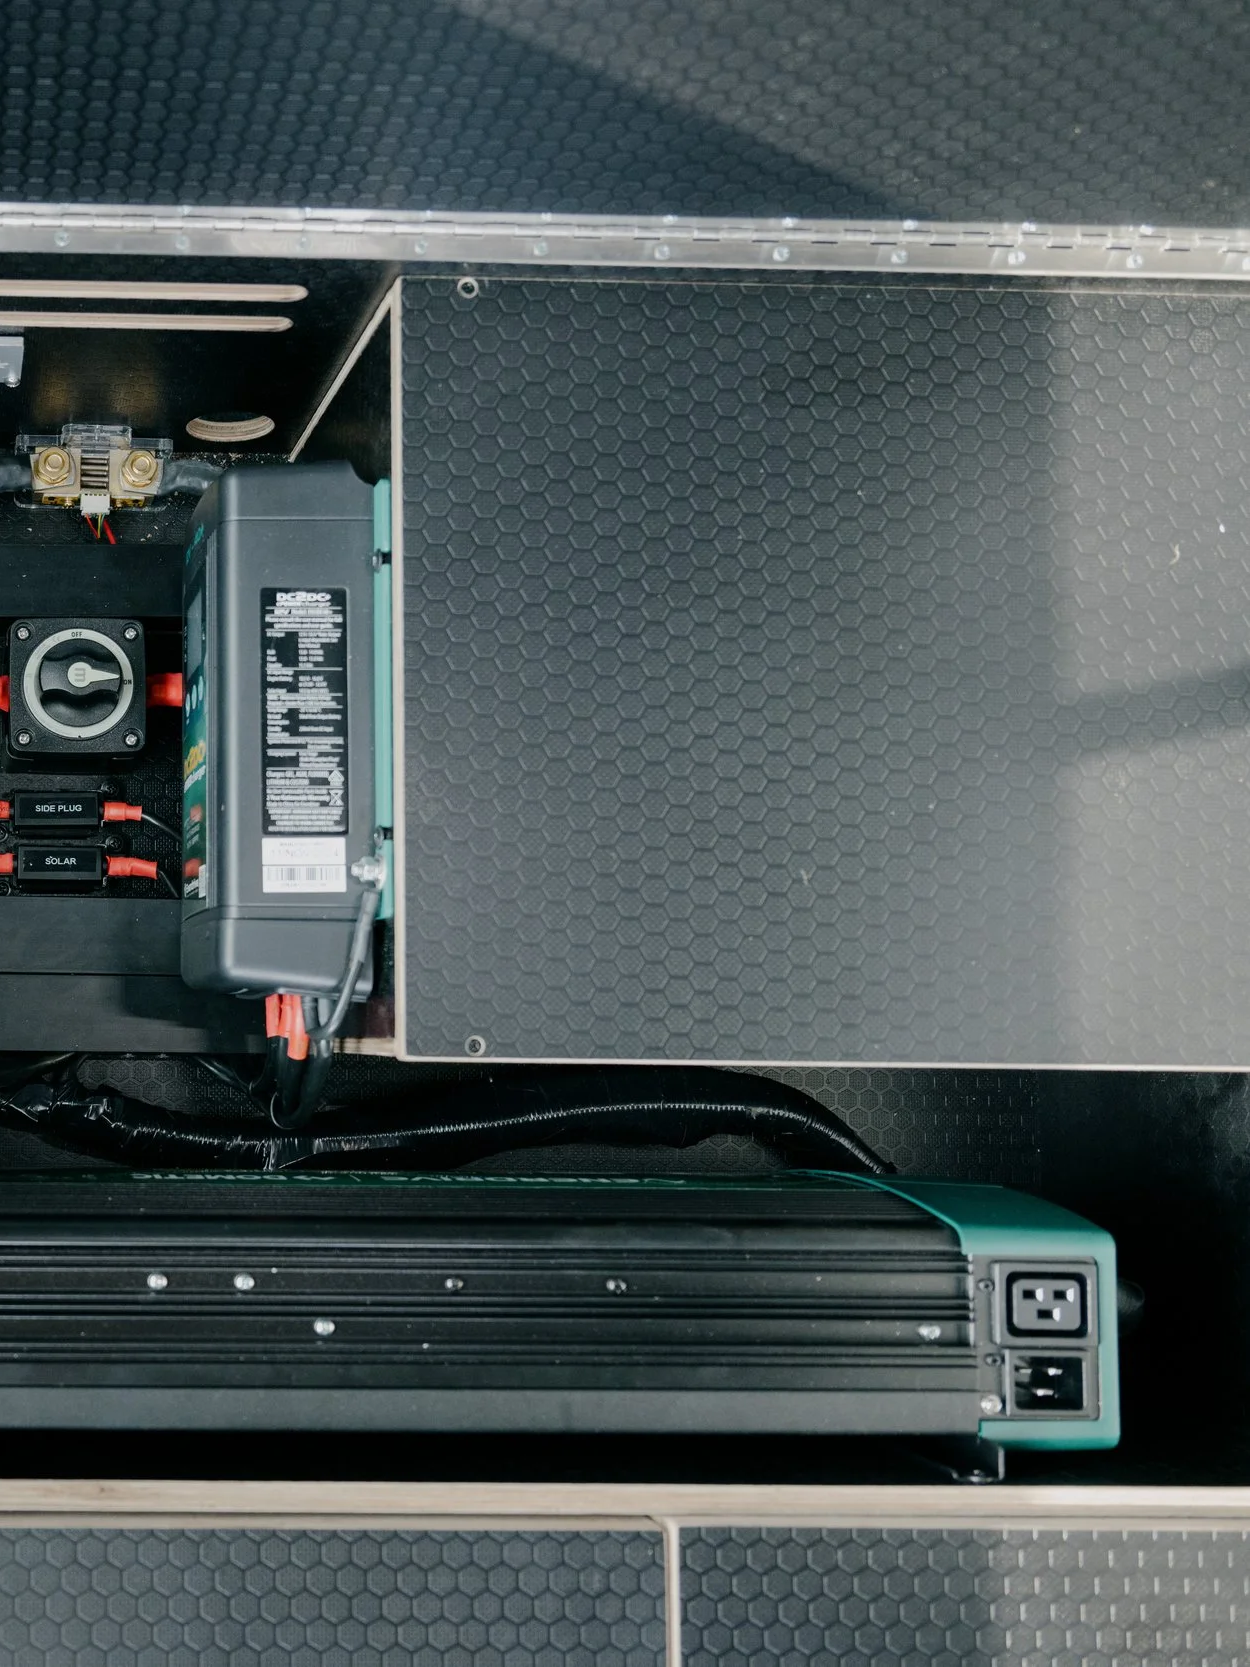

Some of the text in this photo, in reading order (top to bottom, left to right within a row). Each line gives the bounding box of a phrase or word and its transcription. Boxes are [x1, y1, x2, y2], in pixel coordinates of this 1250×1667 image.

[35, 804, 82, 812] SIDE PLUG
[45, 857, 77, 865] SOLAR
[131, 1172, 288, 1181] DOMETIC
